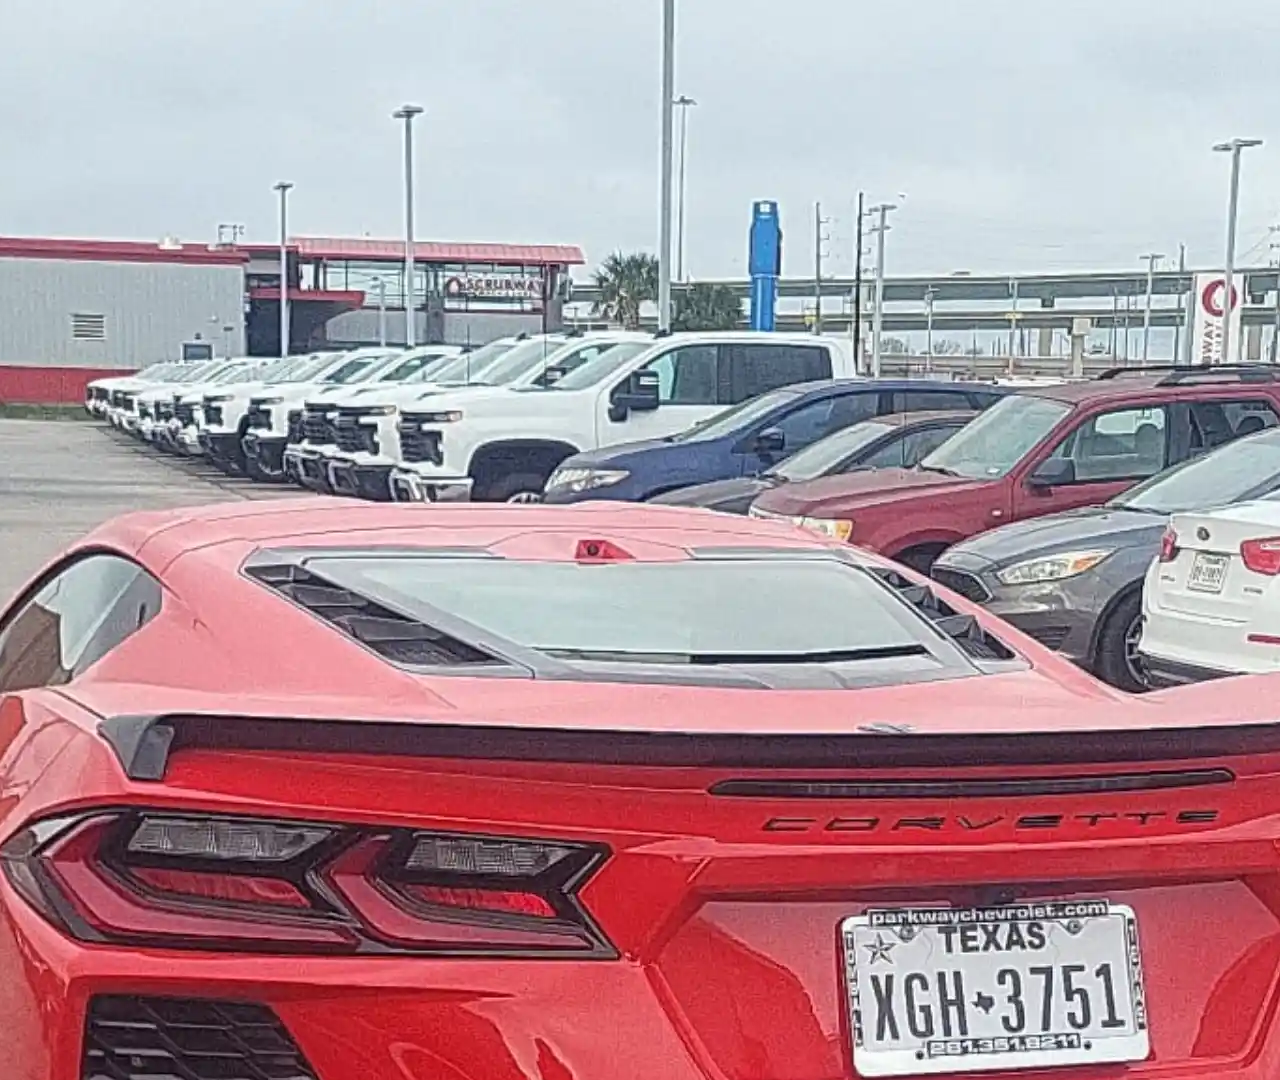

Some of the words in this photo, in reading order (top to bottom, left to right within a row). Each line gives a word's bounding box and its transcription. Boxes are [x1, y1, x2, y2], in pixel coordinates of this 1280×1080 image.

[762, 810, 1218, 832] CORVETTE
[871, 903, 1106, 925] parkwaychevrolet.com
[938, 921, 1046, 953] TEXAS
